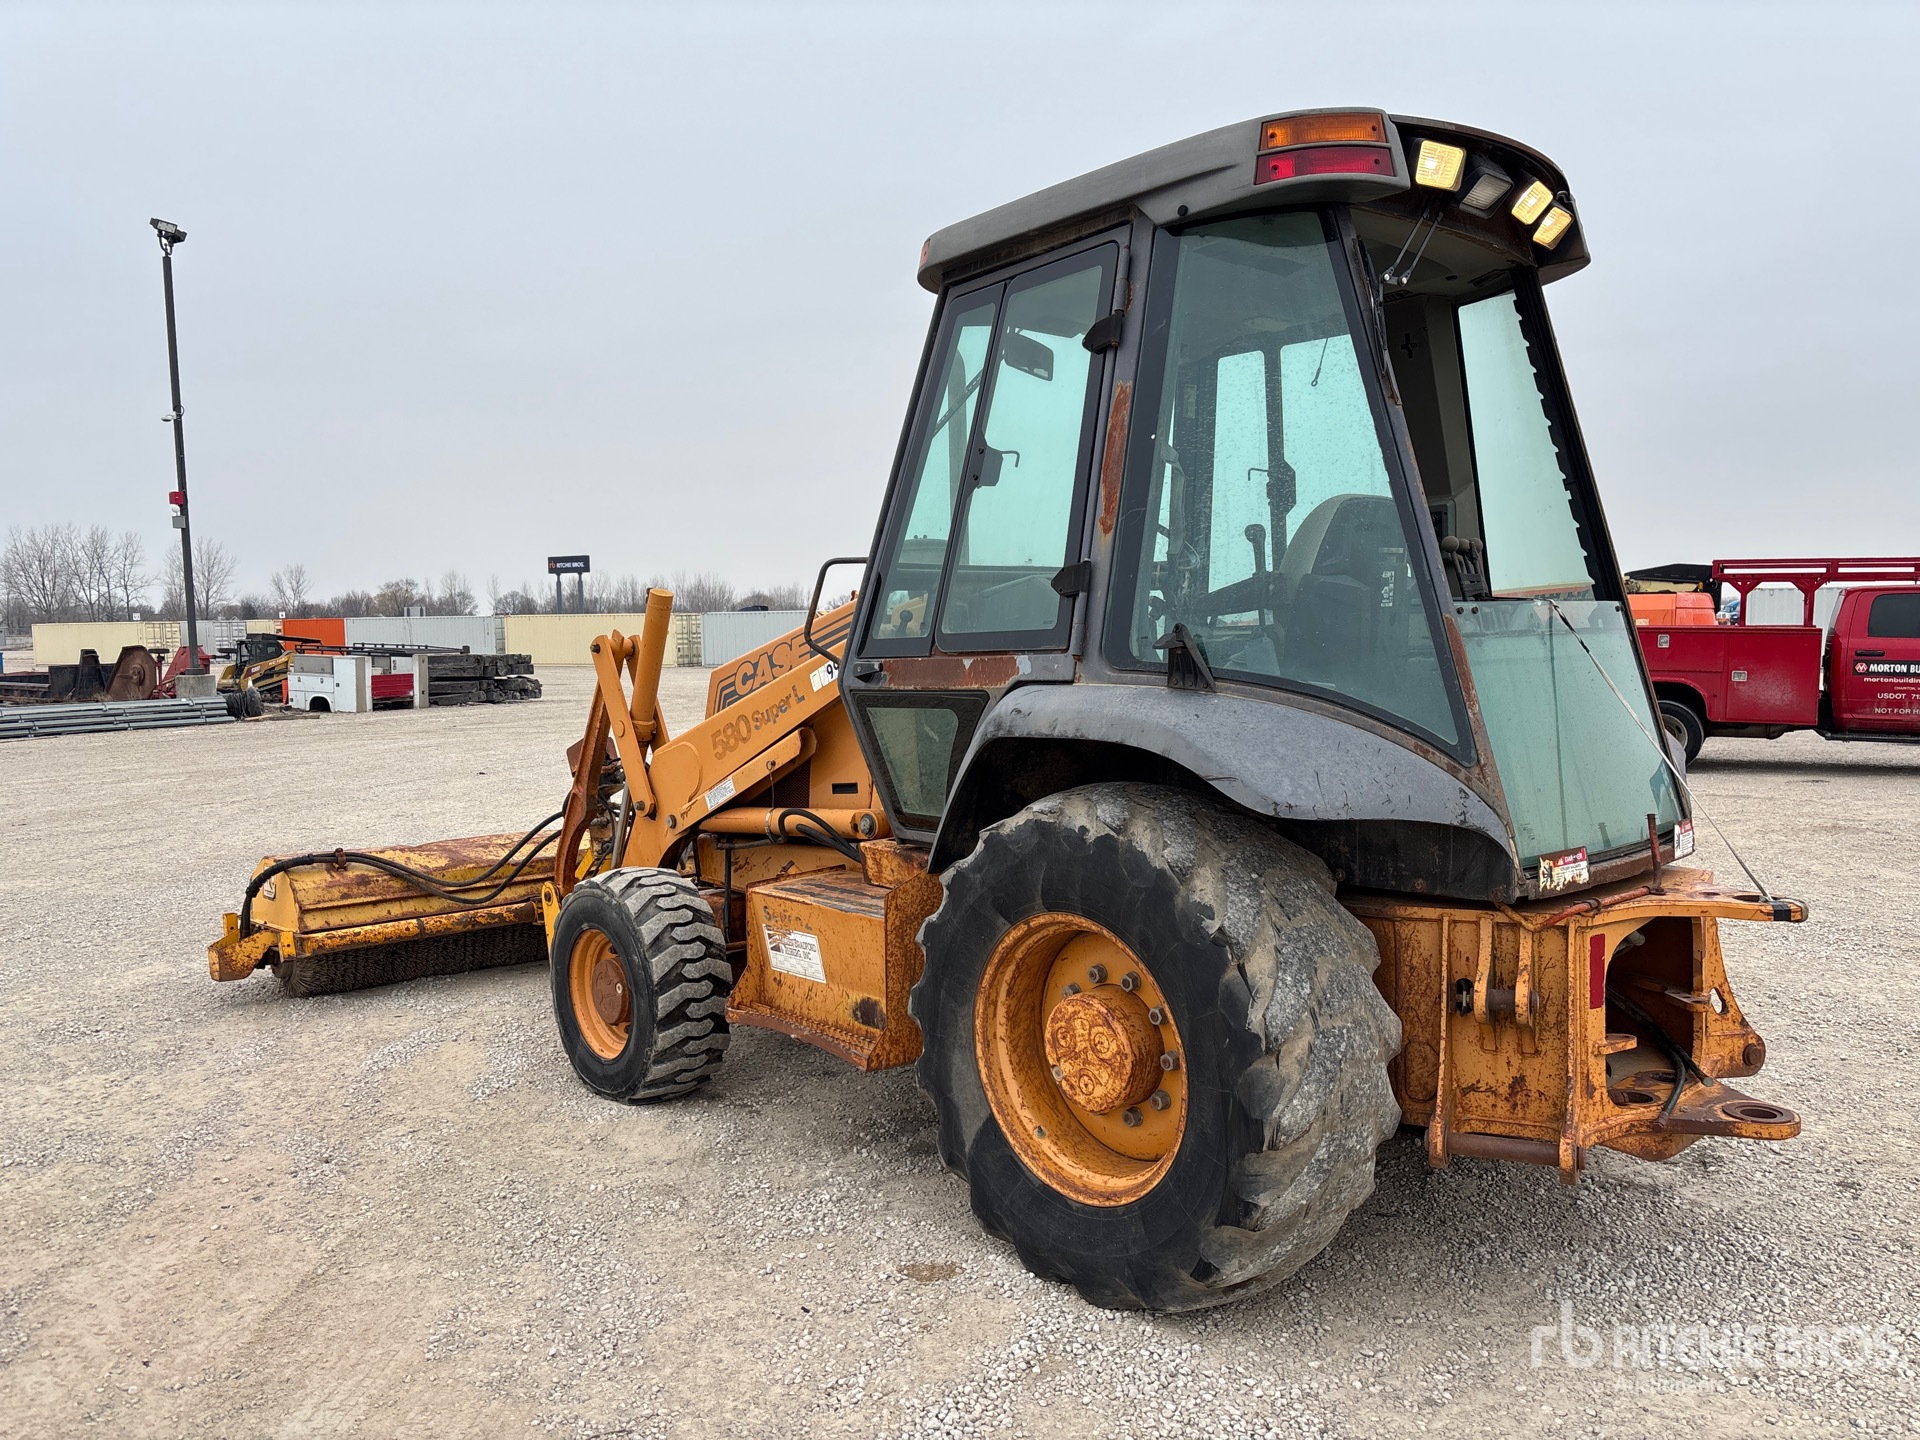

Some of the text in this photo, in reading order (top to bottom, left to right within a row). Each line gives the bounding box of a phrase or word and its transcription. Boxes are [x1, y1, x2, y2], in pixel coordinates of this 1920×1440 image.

[735, 634, 811, 697] CASE
[1869, 663, 1908, 673] MORTON
[1877, 692, 1907, 700] USDOT
[711, 684, 806, 760] 580 Super L
[1564, 852, 1583, 863] DANER
